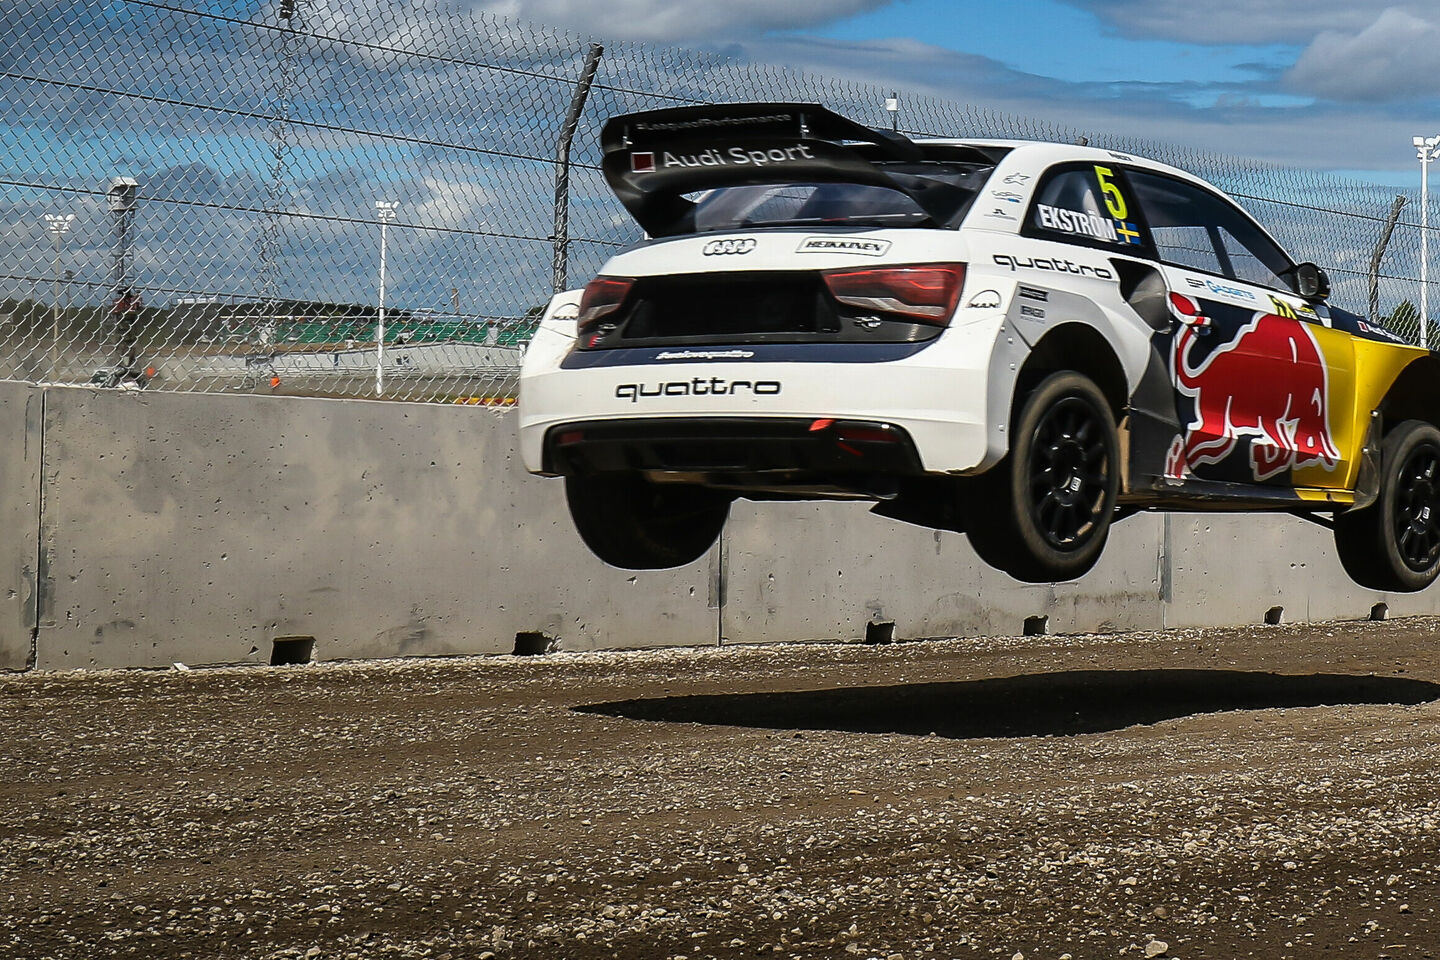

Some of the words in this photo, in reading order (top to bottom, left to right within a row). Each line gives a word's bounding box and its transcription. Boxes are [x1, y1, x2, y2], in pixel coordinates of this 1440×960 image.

[663, 148, 726, 168] Audi
[727, 143, 815, 167] Sport
[1094, 165, 1128, 220] 5
[1037, 203, 1118, 241] EKSTRÖM
[992, 254, 1112, 280] quattro
[615, 377, 781, 402] quattro
